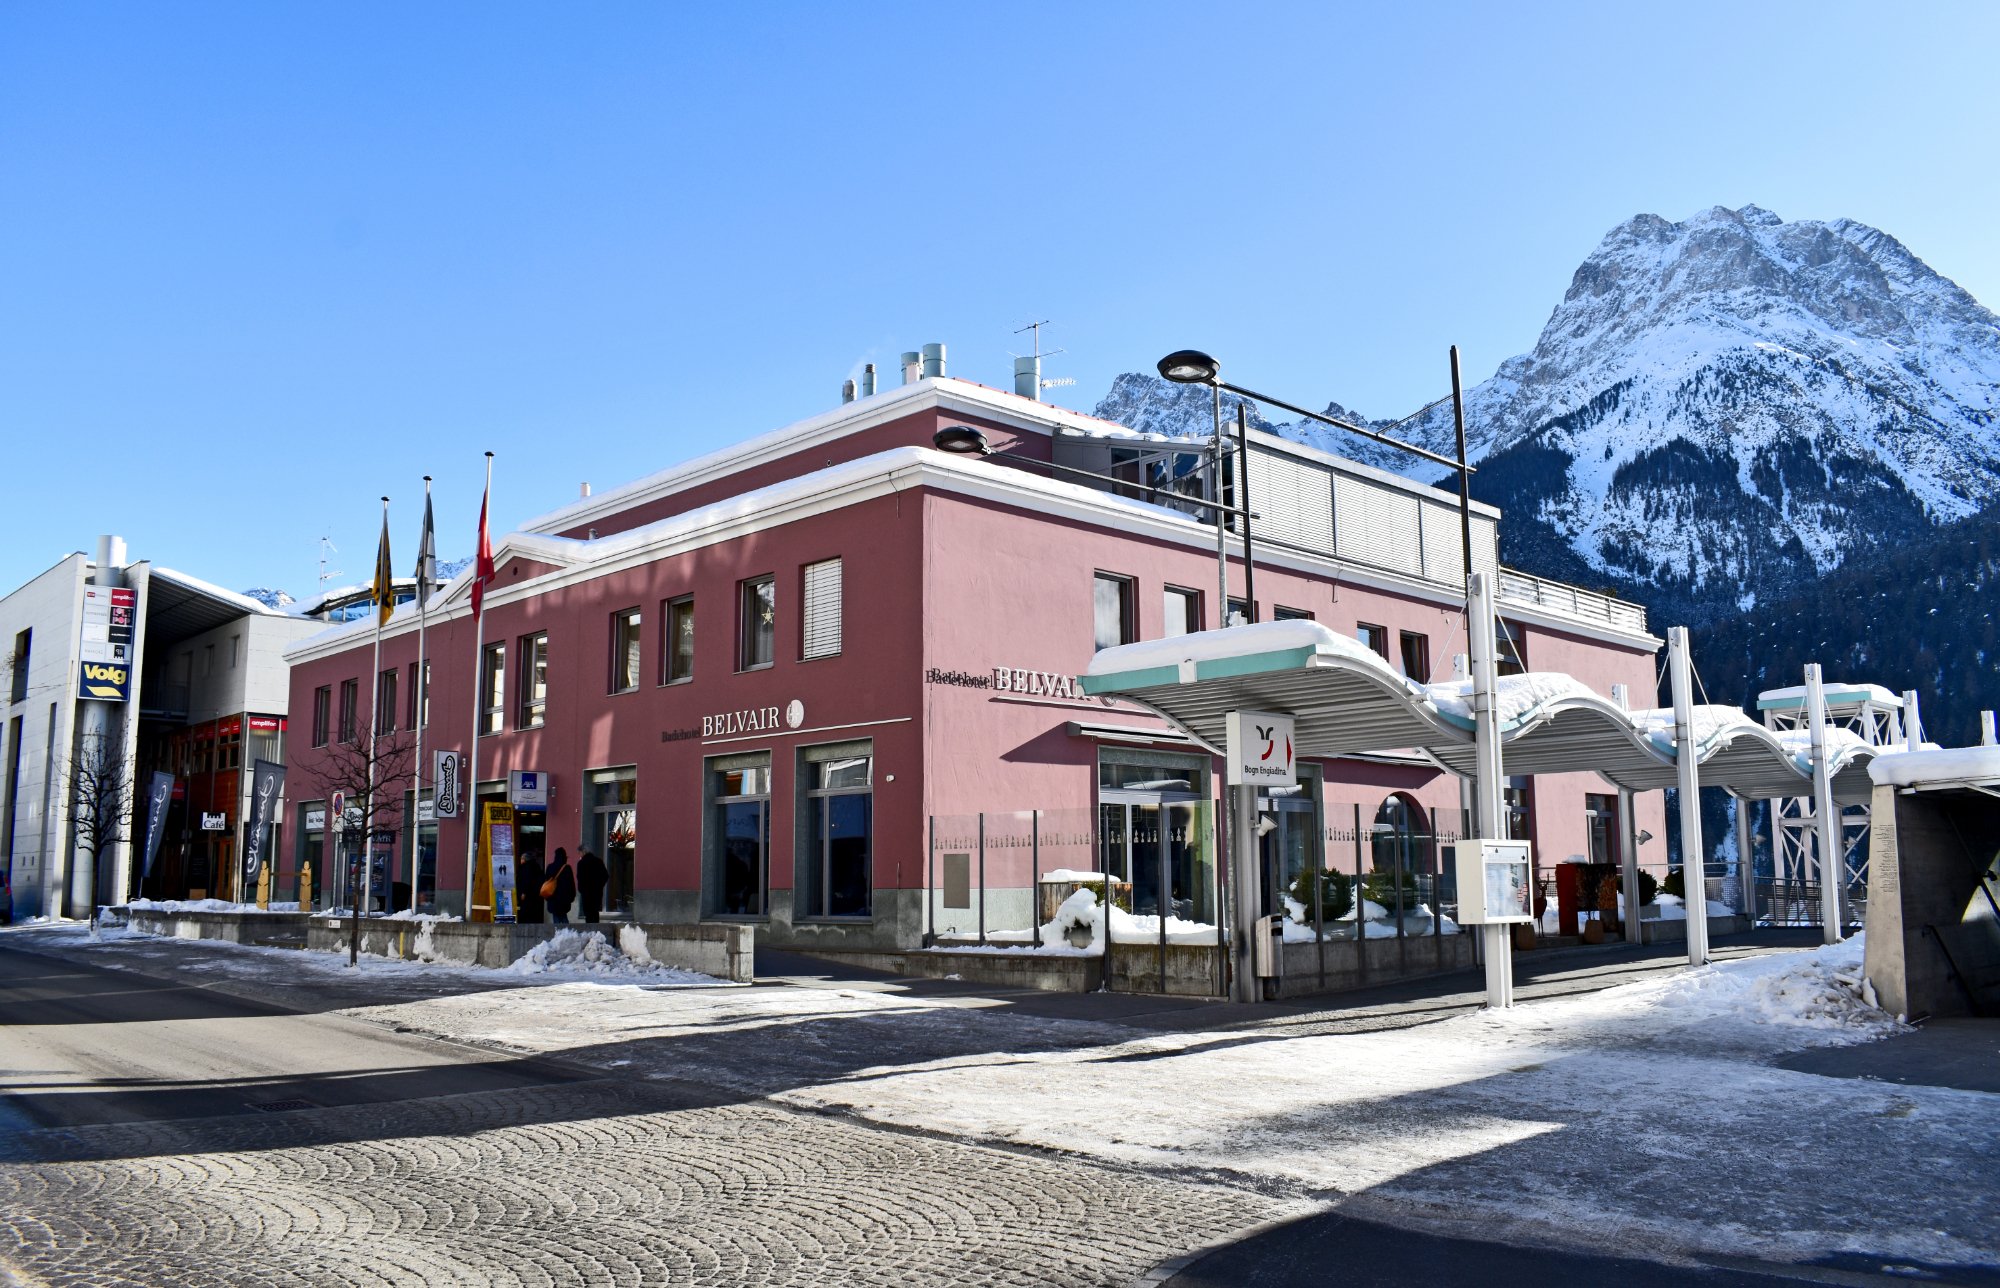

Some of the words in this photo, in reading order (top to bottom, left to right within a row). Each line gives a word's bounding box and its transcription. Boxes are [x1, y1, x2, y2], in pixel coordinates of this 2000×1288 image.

[84, 664, 127, 685] Volg
[997, 666, 1096, 699] BELVAI
[702, 706, 780, 737] BELVAIR
[1244, 765, 1259, 776] Bogn
[1260, 766, 1287, 776] Engiadina
[203, 820, 224, 829] Café
